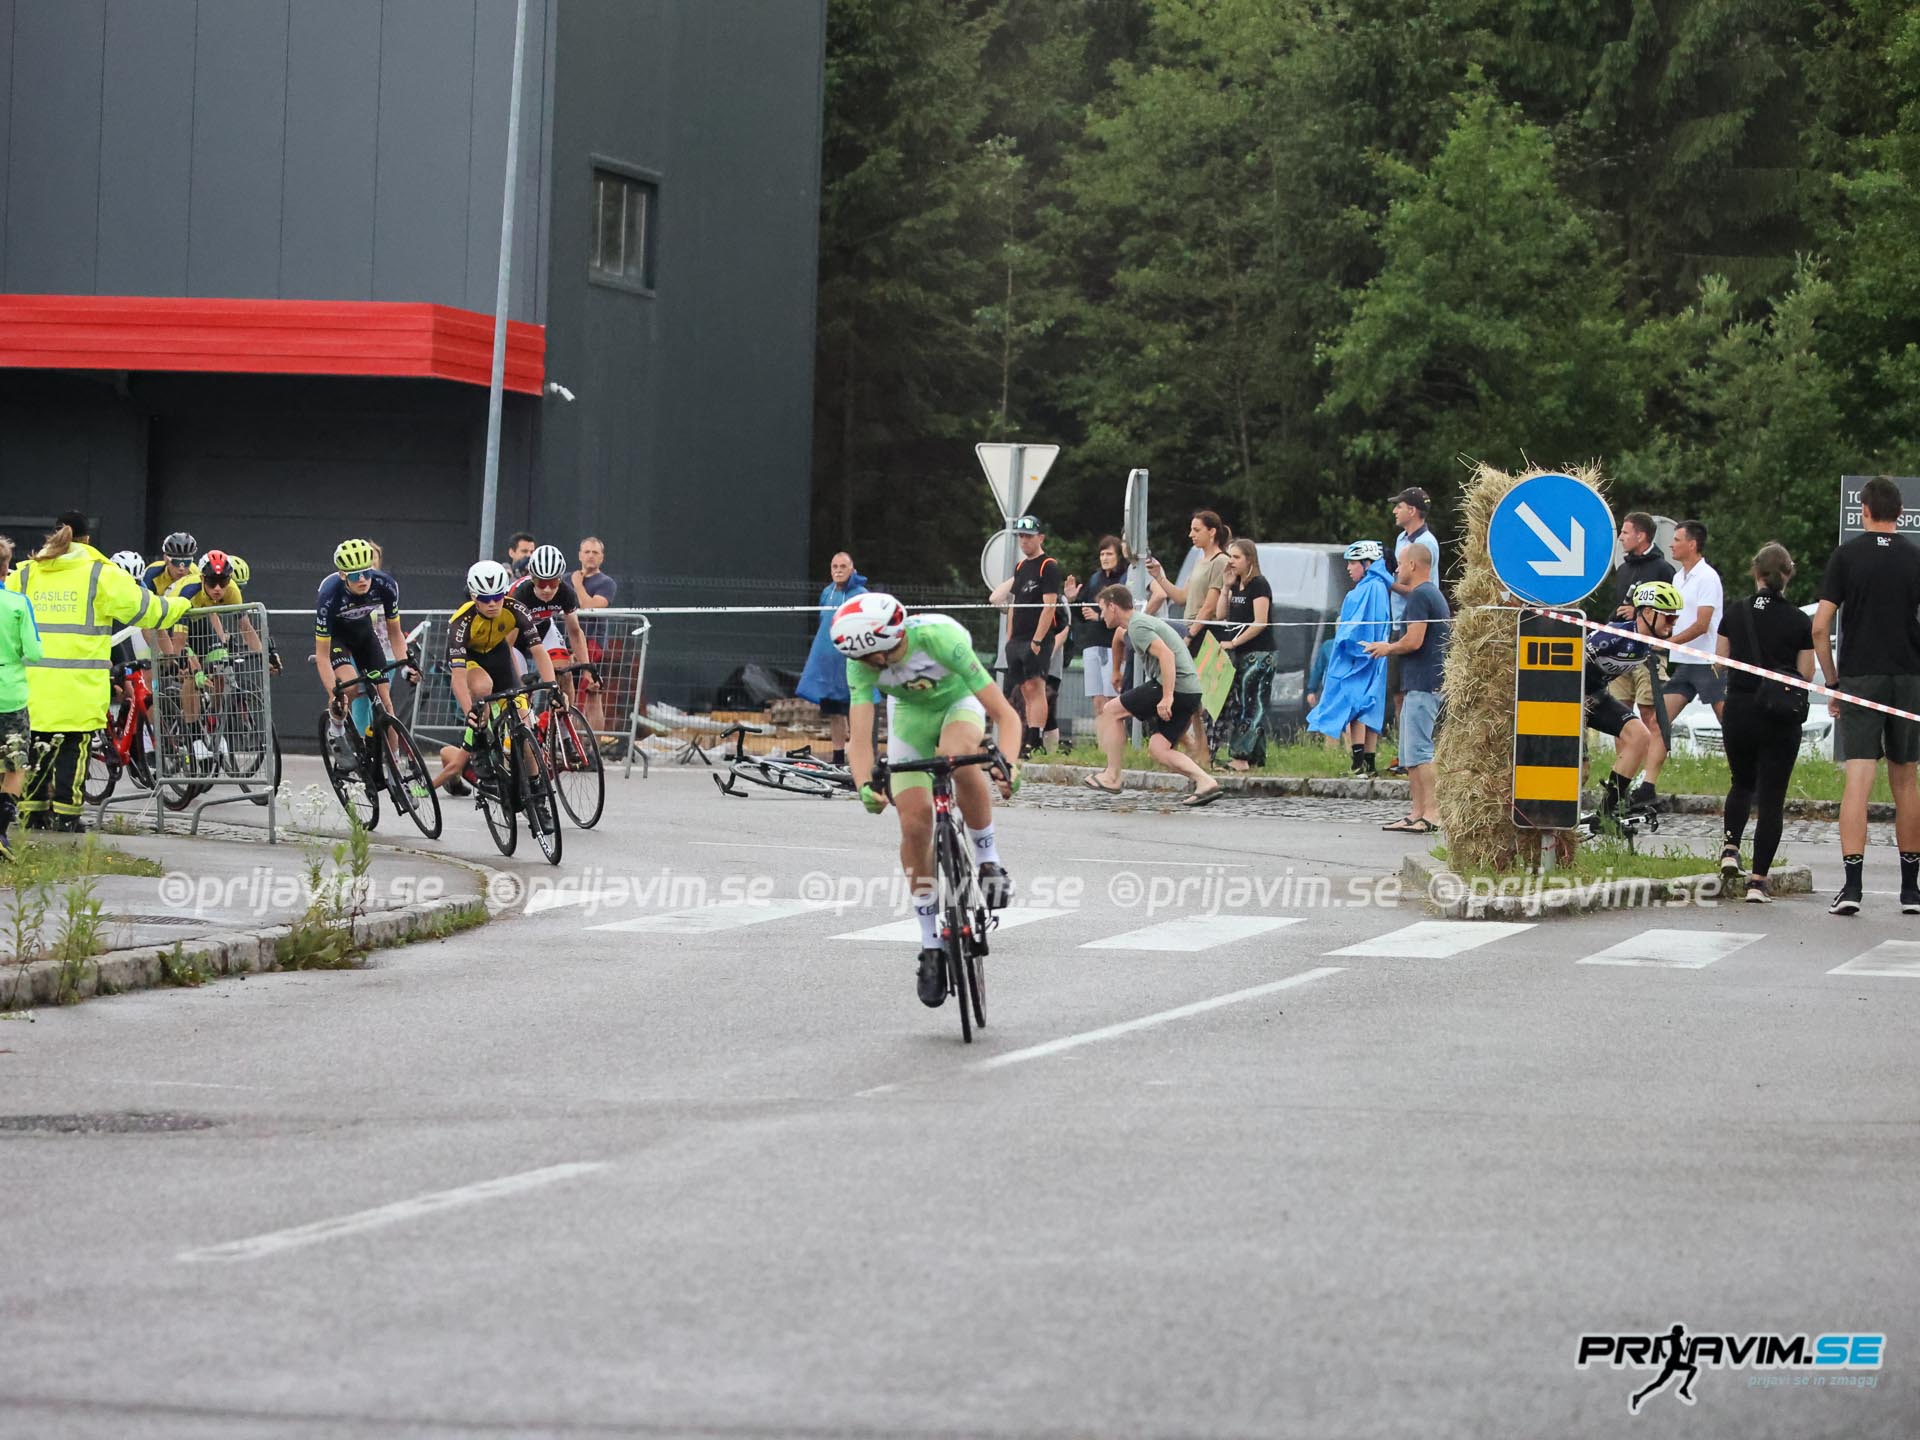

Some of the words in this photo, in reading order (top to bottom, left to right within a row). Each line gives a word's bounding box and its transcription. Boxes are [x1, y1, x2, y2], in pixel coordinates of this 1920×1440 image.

[33, 591, 78, 602] GASILEC
[1638, 590, 1655, 601] 205
[50, 603, 77, 613] MOSTE
[455, 620, 468, 643] CELJE
[846, 631, 876, 651] 216
